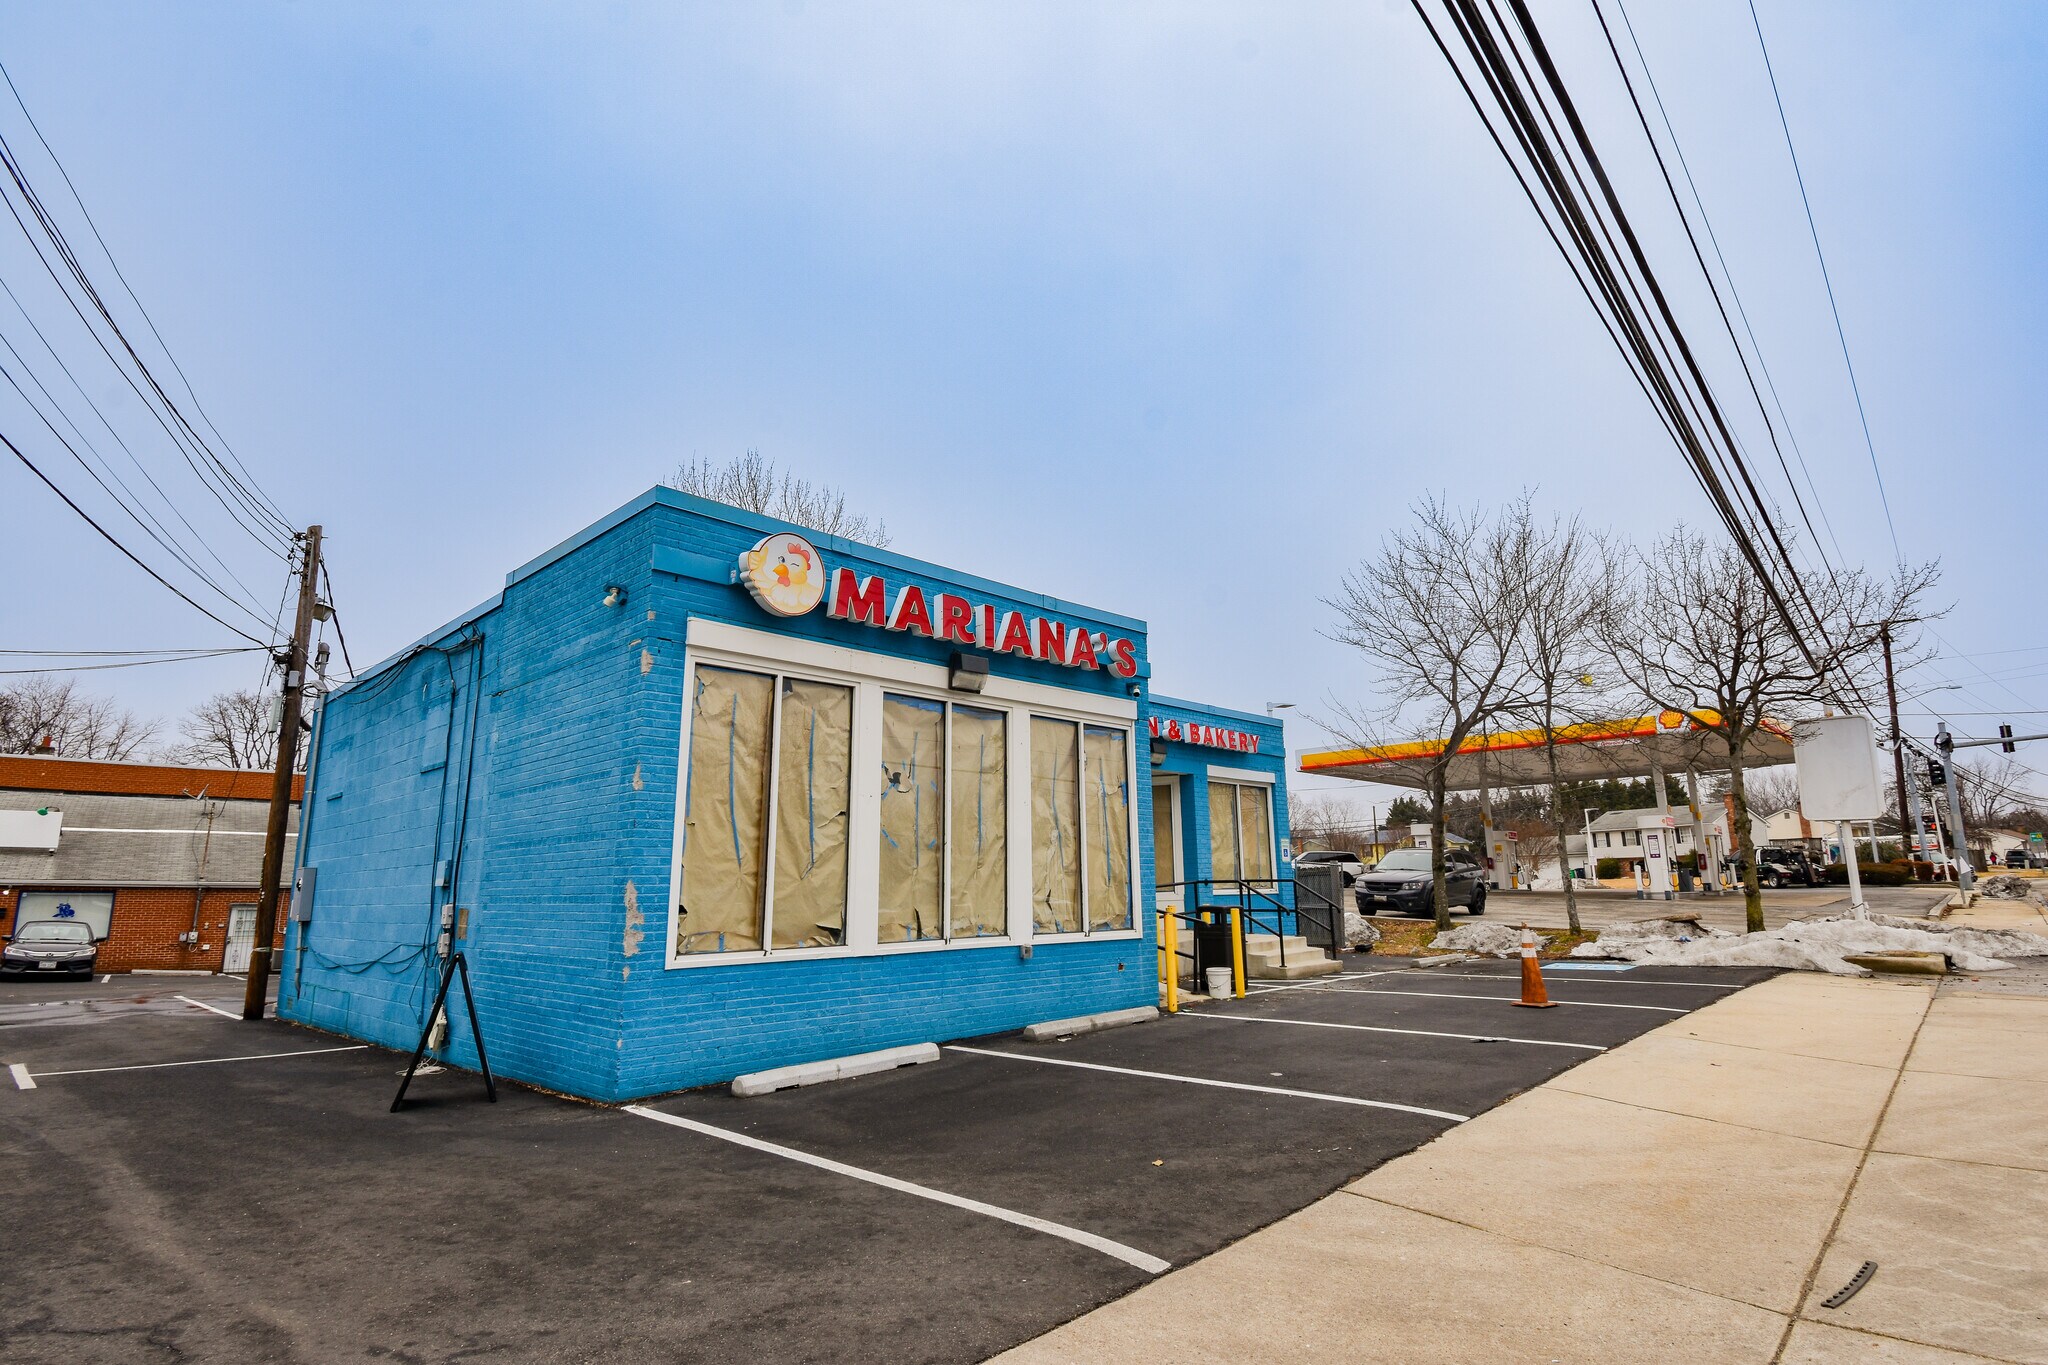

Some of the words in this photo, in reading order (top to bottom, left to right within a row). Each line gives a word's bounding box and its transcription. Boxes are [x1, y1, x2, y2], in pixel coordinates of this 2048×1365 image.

[829, 568, 1137, 677] MARIANA'S
[1164, 719, 1181, 741] &
[1185, 723, 1260, 753] BAKERY
